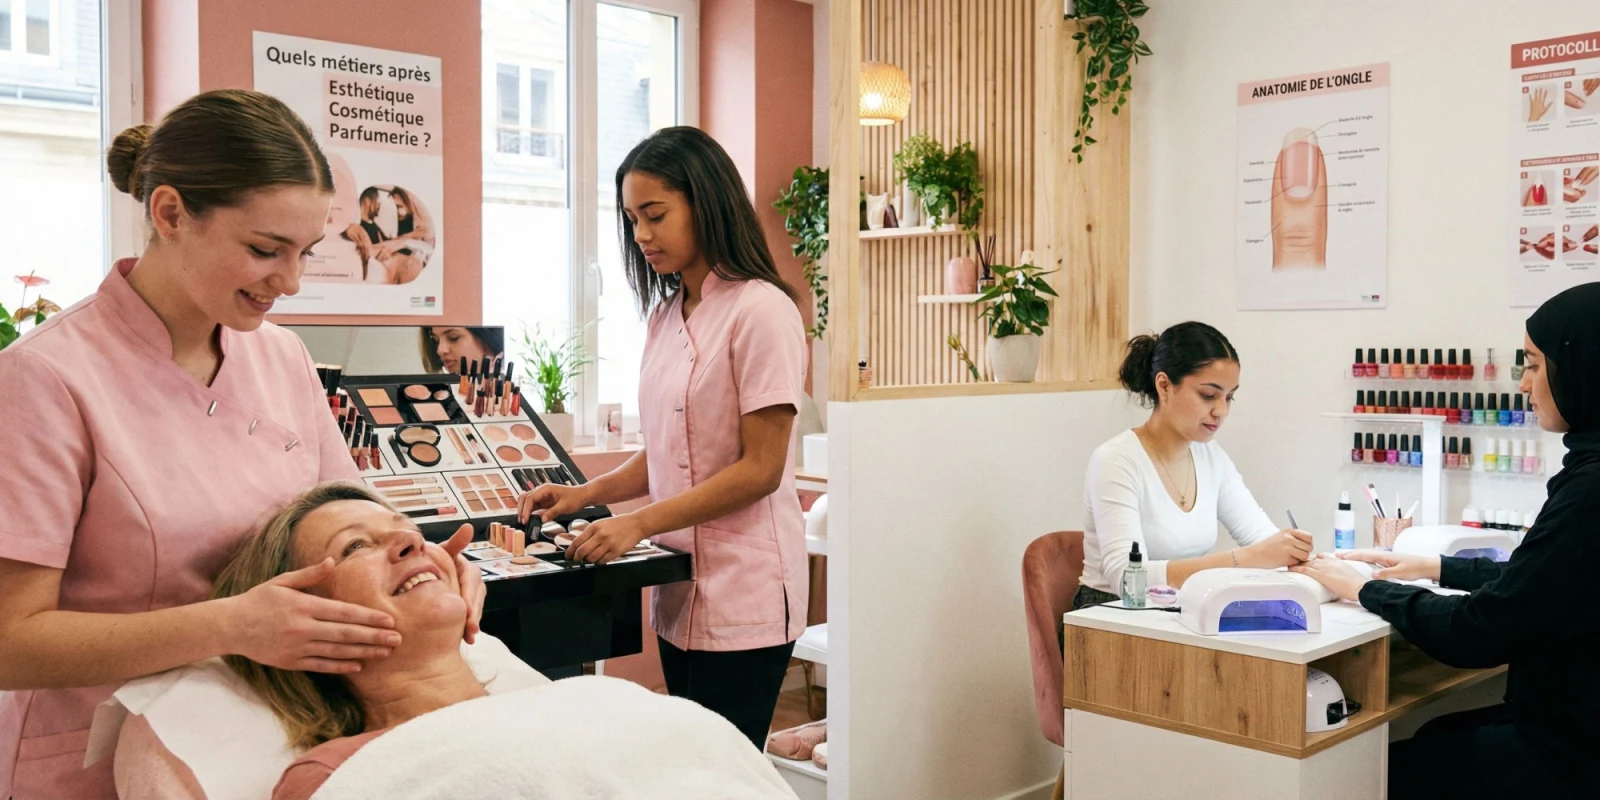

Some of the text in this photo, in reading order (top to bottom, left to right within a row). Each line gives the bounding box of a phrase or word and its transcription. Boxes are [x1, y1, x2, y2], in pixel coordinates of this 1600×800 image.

[1522, 39, 1600, 61] PROTOCOLL
[266, 46, 431, 82] Quels métiers après
[329, 80, 415, 106] Esthétique
[1252, 70, 1372, 98] ANATOMIE DE L’ONGLE
[329, 102, 424, 128] Cosmétique
[330, 123, 431, 147] Parfumerie ?
